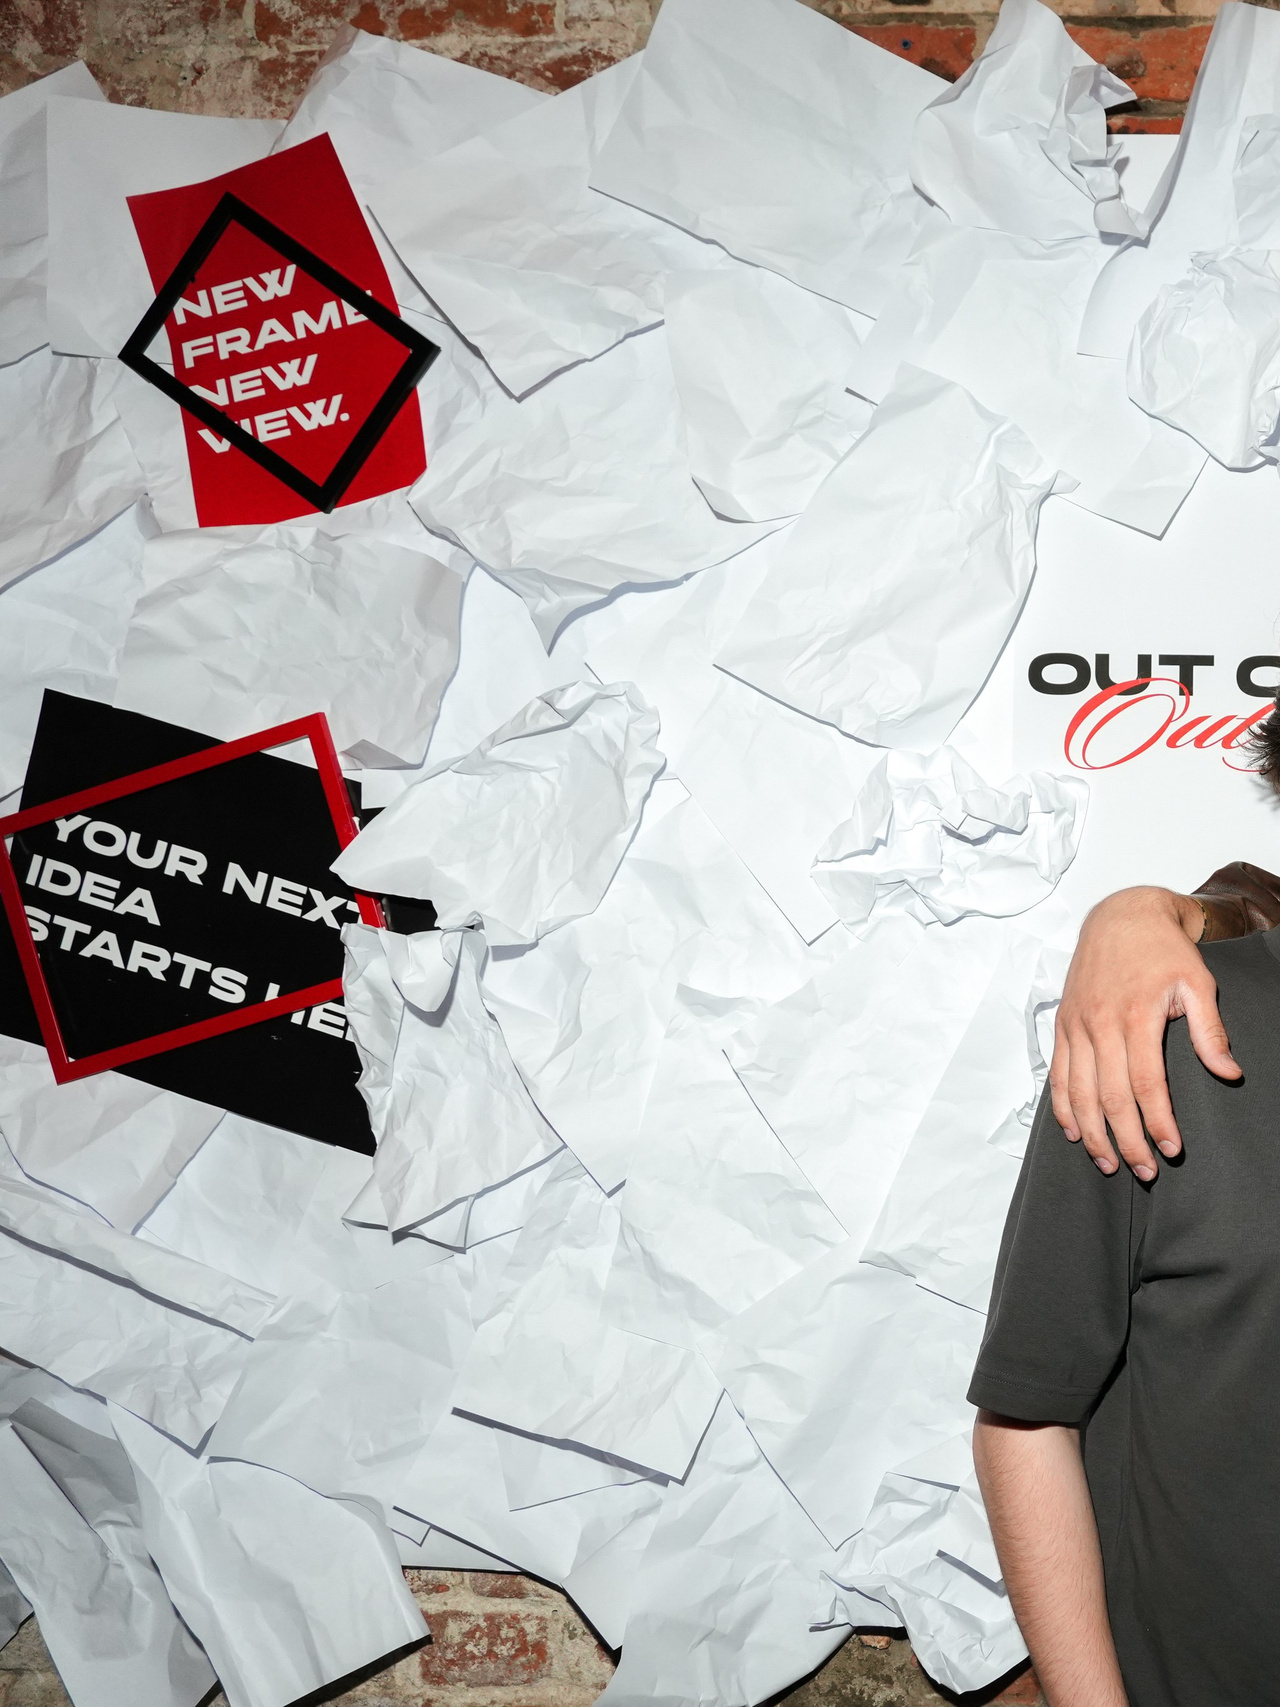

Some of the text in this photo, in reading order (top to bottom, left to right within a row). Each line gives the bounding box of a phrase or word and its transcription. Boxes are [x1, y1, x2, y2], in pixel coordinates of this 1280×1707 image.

[173, 263, 297, 326] NEW
[188, 353, 318, 407] NEW
[1028, 652, 1215, 697] OUT
[54, 814, 208, 886] YOUR
[25, 853, 161, 927] IDEA
[23, 904, 249, 1004] STARTS
